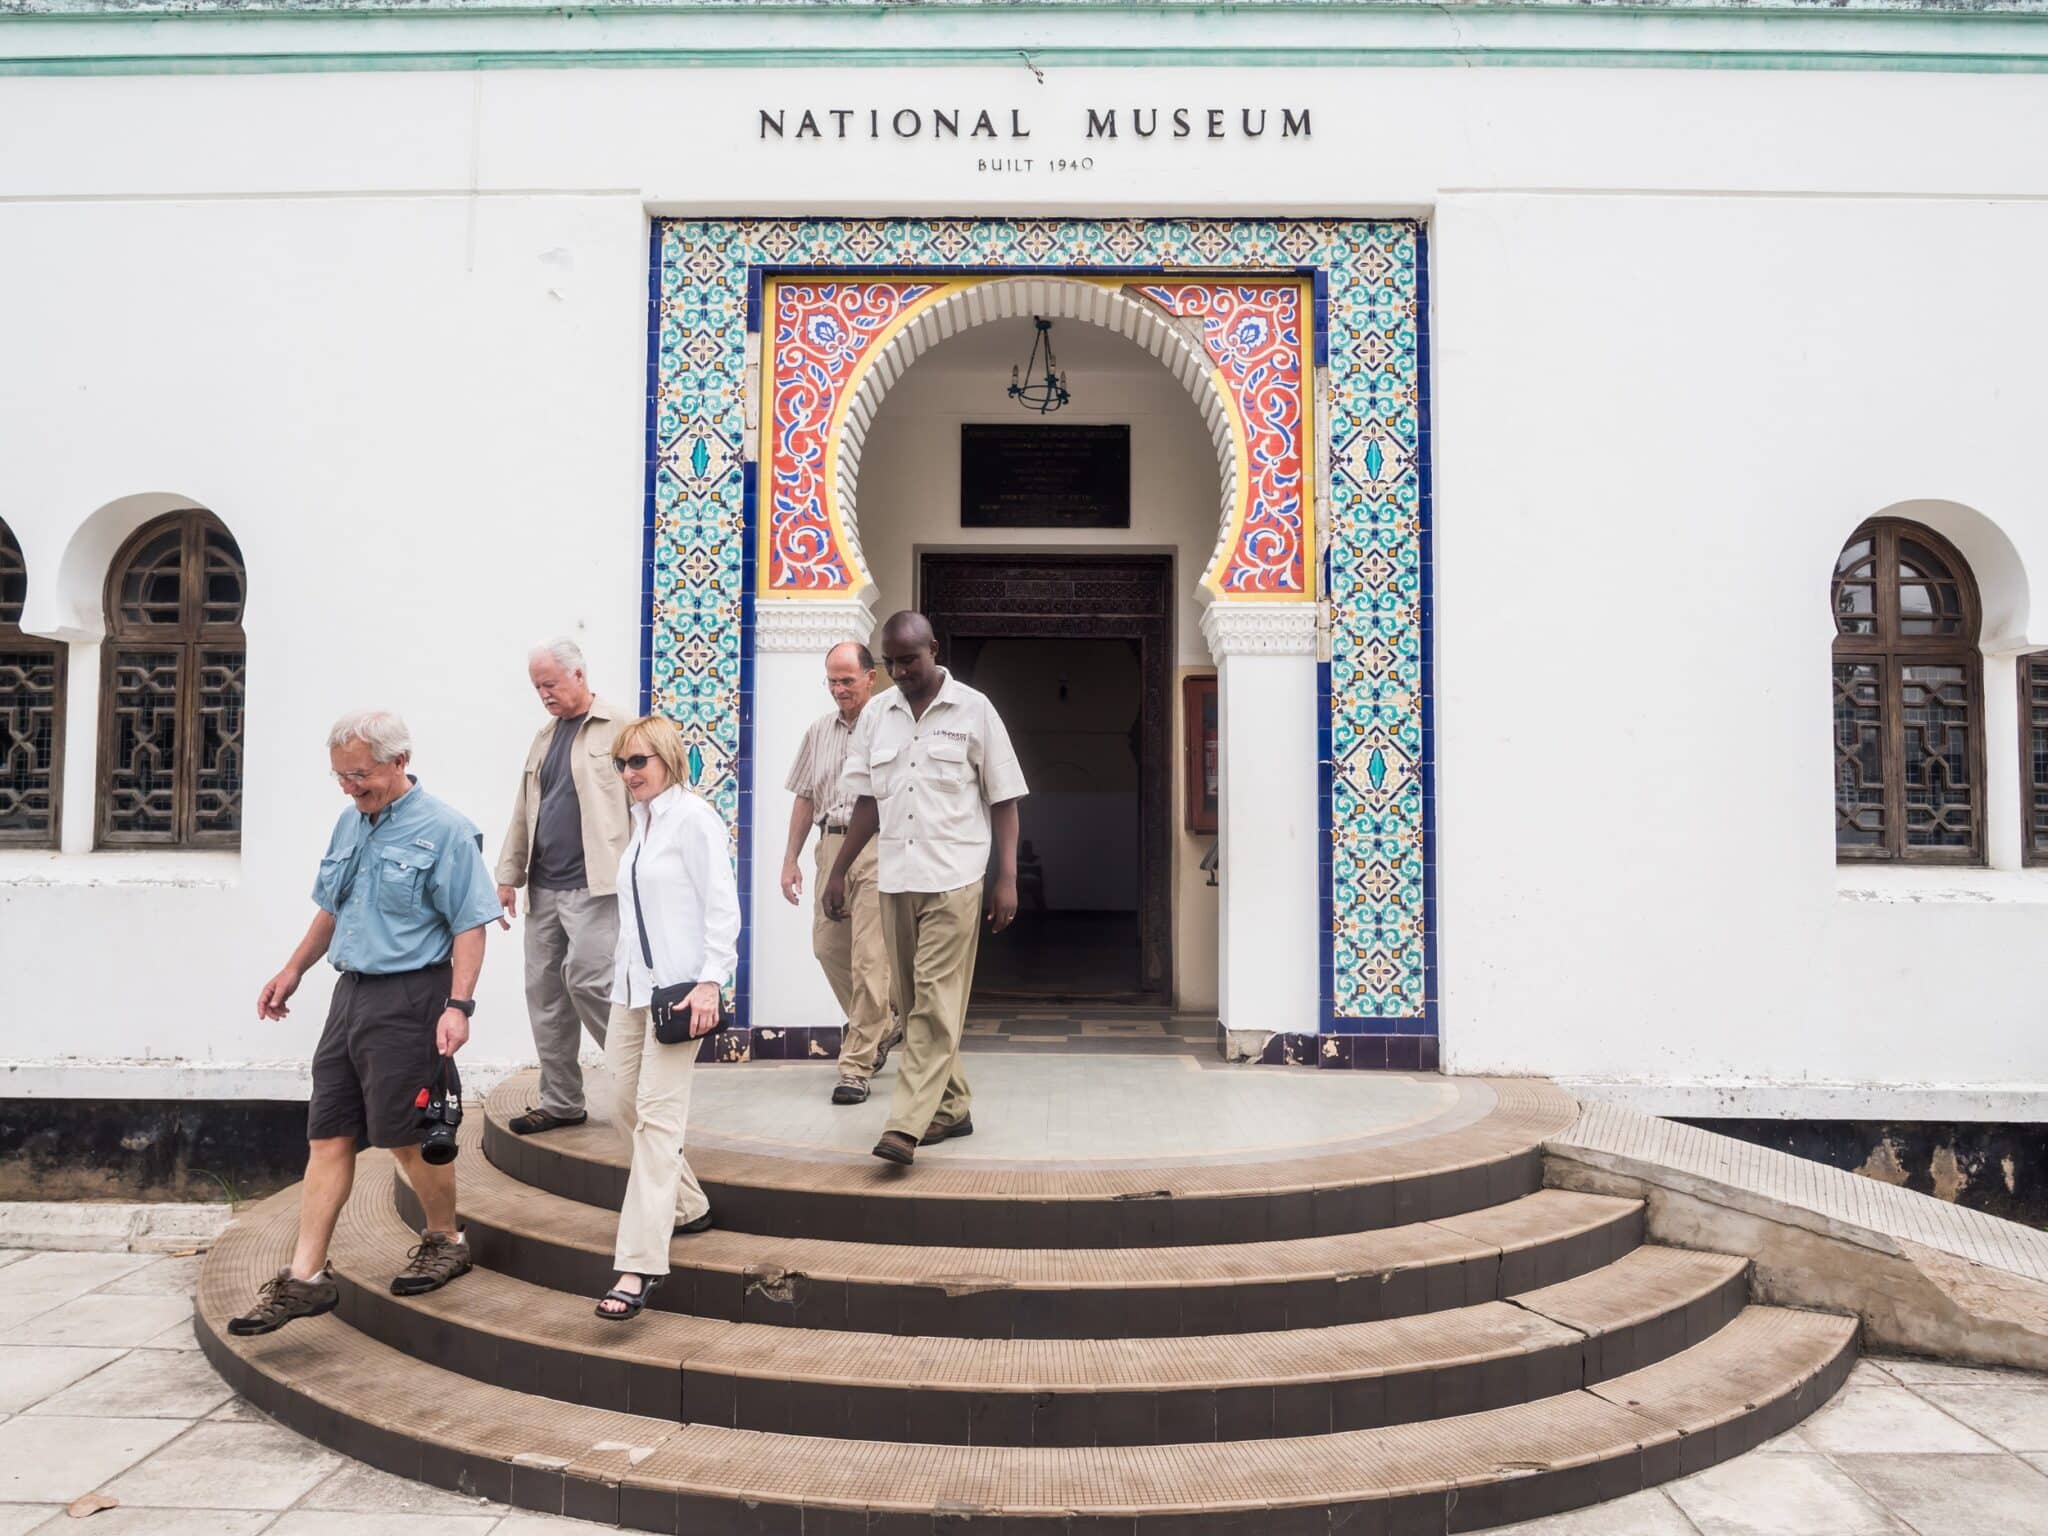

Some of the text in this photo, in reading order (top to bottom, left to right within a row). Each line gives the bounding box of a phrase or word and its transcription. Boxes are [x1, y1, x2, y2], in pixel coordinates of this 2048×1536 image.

[760, 108, 1312, 138] NATIONAL MUSEUM
[977, 157, 1095, 173] BUILT 1940
